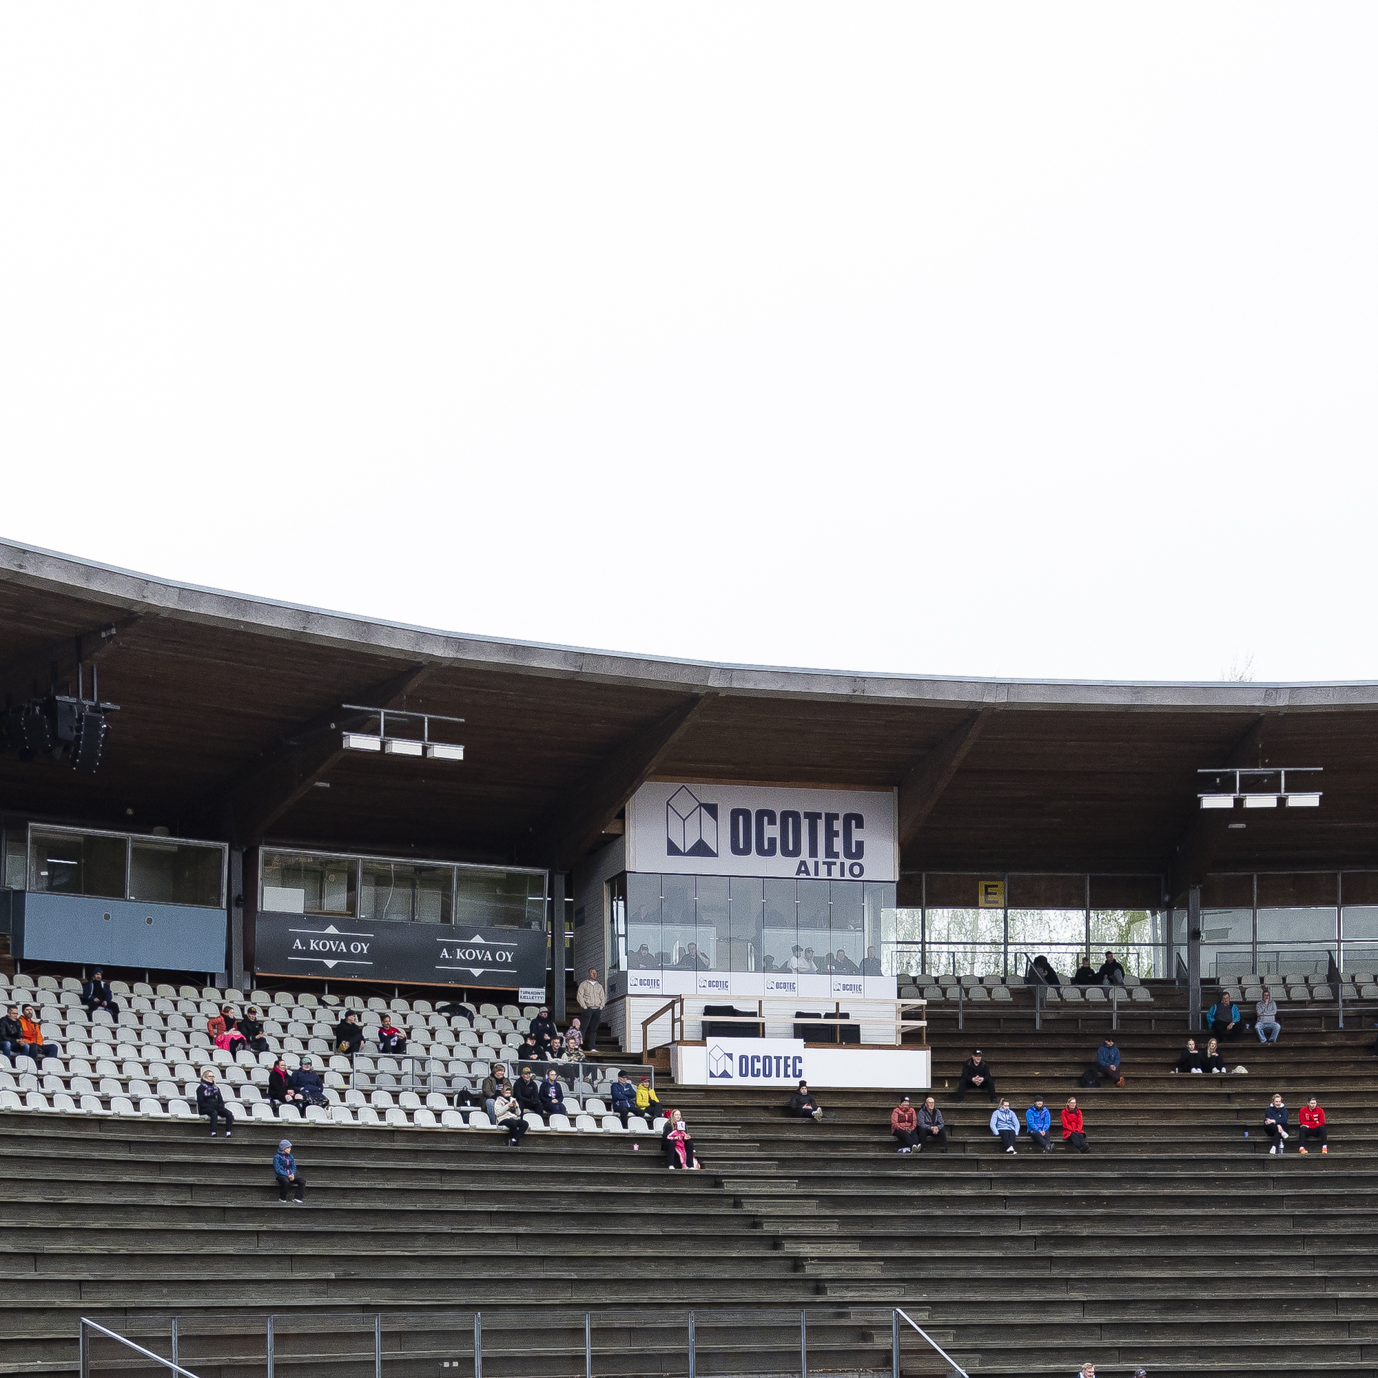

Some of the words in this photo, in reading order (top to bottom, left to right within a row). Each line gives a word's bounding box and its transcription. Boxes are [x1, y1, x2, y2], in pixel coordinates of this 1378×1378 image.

[730, 807, 865, 860] OCOTEC
[795, 860, 865, 878] AITIO
[984, 884, 999, 904] E
[292, 938, 306, 950] A.
[310, 939, 347, 953] KOVA
[350, 941, 370, 954] OY
[440, 948, 453, 959] A.
[456, 949, 492, 962] KOVA
[495, 951, 514, 963] OY
[639, 979, 660, 987] OCOTEC
[708, 980, 728, 988] OCOTEC
[776, 981, 796, 990] OCOTEC
[842, 983, 862, 991] OCOTEC
[739, 1054, 803, 1078] OCOTEC
